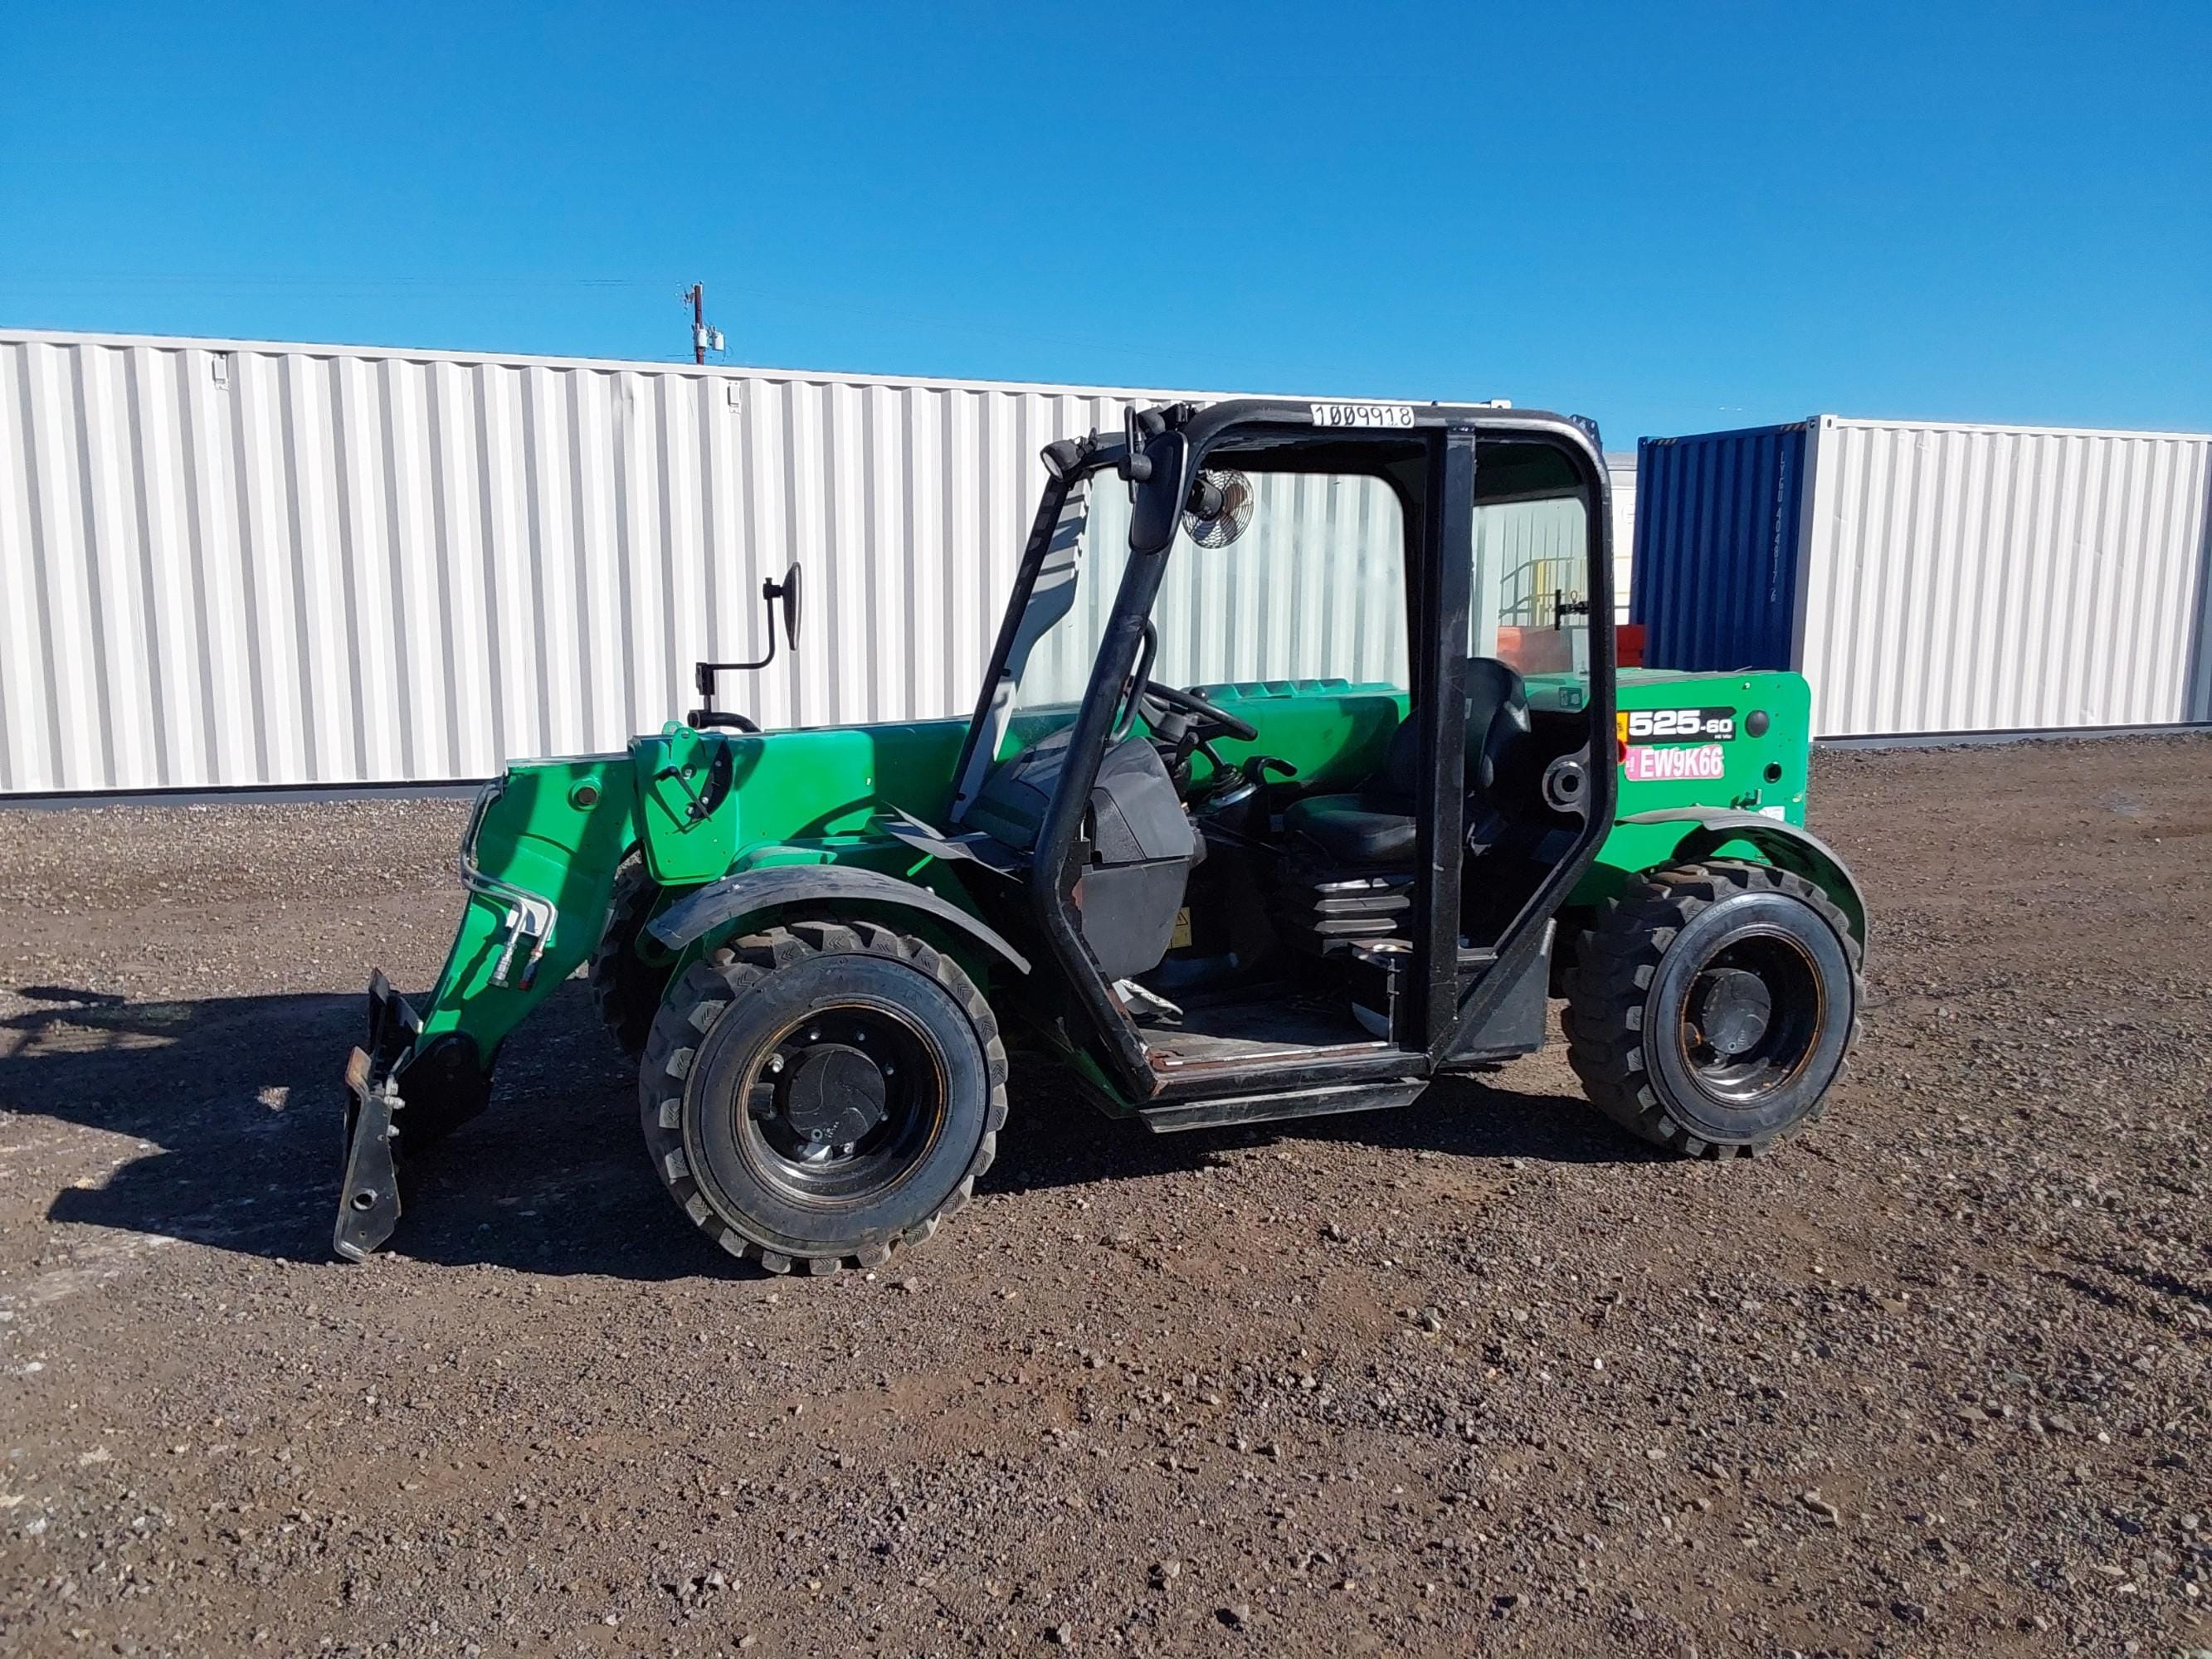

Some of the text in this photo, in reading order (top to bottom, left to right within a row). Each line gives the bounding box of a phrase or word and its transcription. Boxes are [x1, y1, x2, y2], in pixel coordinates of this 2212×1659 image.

[1315, 406, 1411, 426] 1009918
[1629, 710, 1732, 737] 525-60
[1640, 746, 1722, 778] EW9K66
